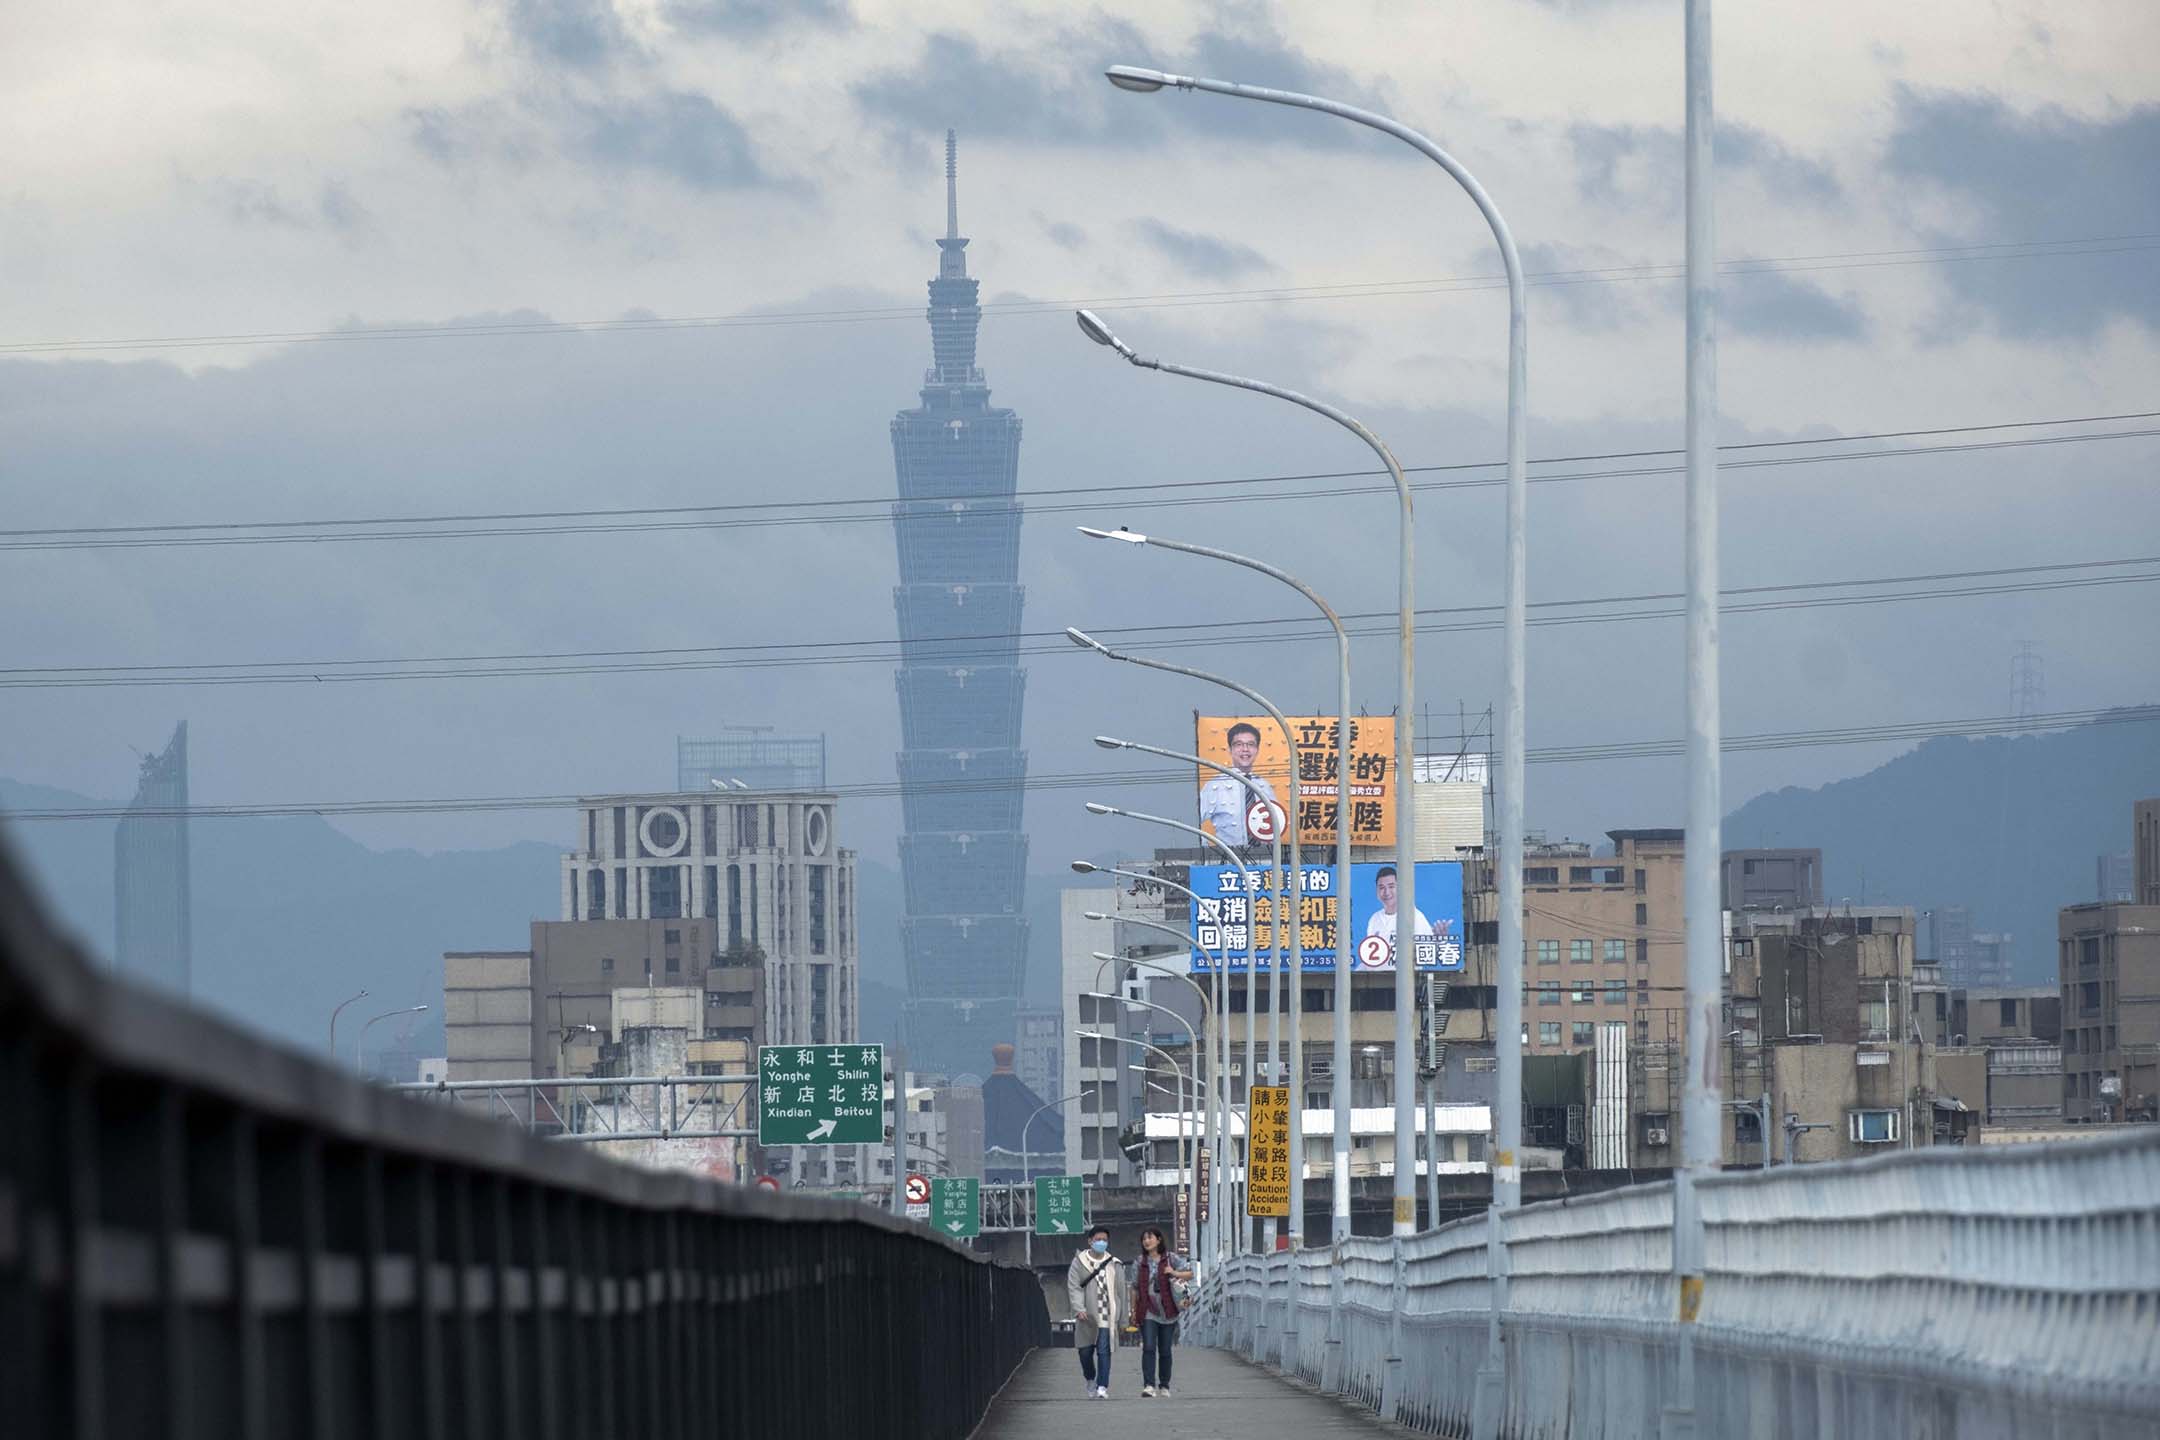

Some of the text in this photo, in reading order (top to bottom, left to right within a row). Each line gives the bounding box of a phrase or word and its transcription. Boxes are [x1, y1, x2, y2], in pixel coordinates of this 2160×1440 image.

[1297, 720, 1359, 750] 立委
[1298, 752, 1387, 782] 選好的
[1254, 805, 1274, 837] 3
[1368, 942, 1380, 961] 2
[763, 1048, 878, 1067] 永和 士林
[768, 1070, 869, 1083] Yonghe Shilin
[764, 1083, 879, 1104] 新店 北投
[768, 1106, 873, 1118] Xindian Beitou
[1252, 1090, 1270, 1182] 請小心駕駛
[1271, 1090, 1289, 1182] 易肇事路段
[944, 1180, 967, 1192] 永和
[1048, 1178, 1070, 1188] 士林
[944, 1199, 967, 1209] 新店
[1048, 1196, 1071, 1207] 北投
[1250, 1194, 1288, 1204] Accident
[1250, 1204, 1272, 1214] Area
